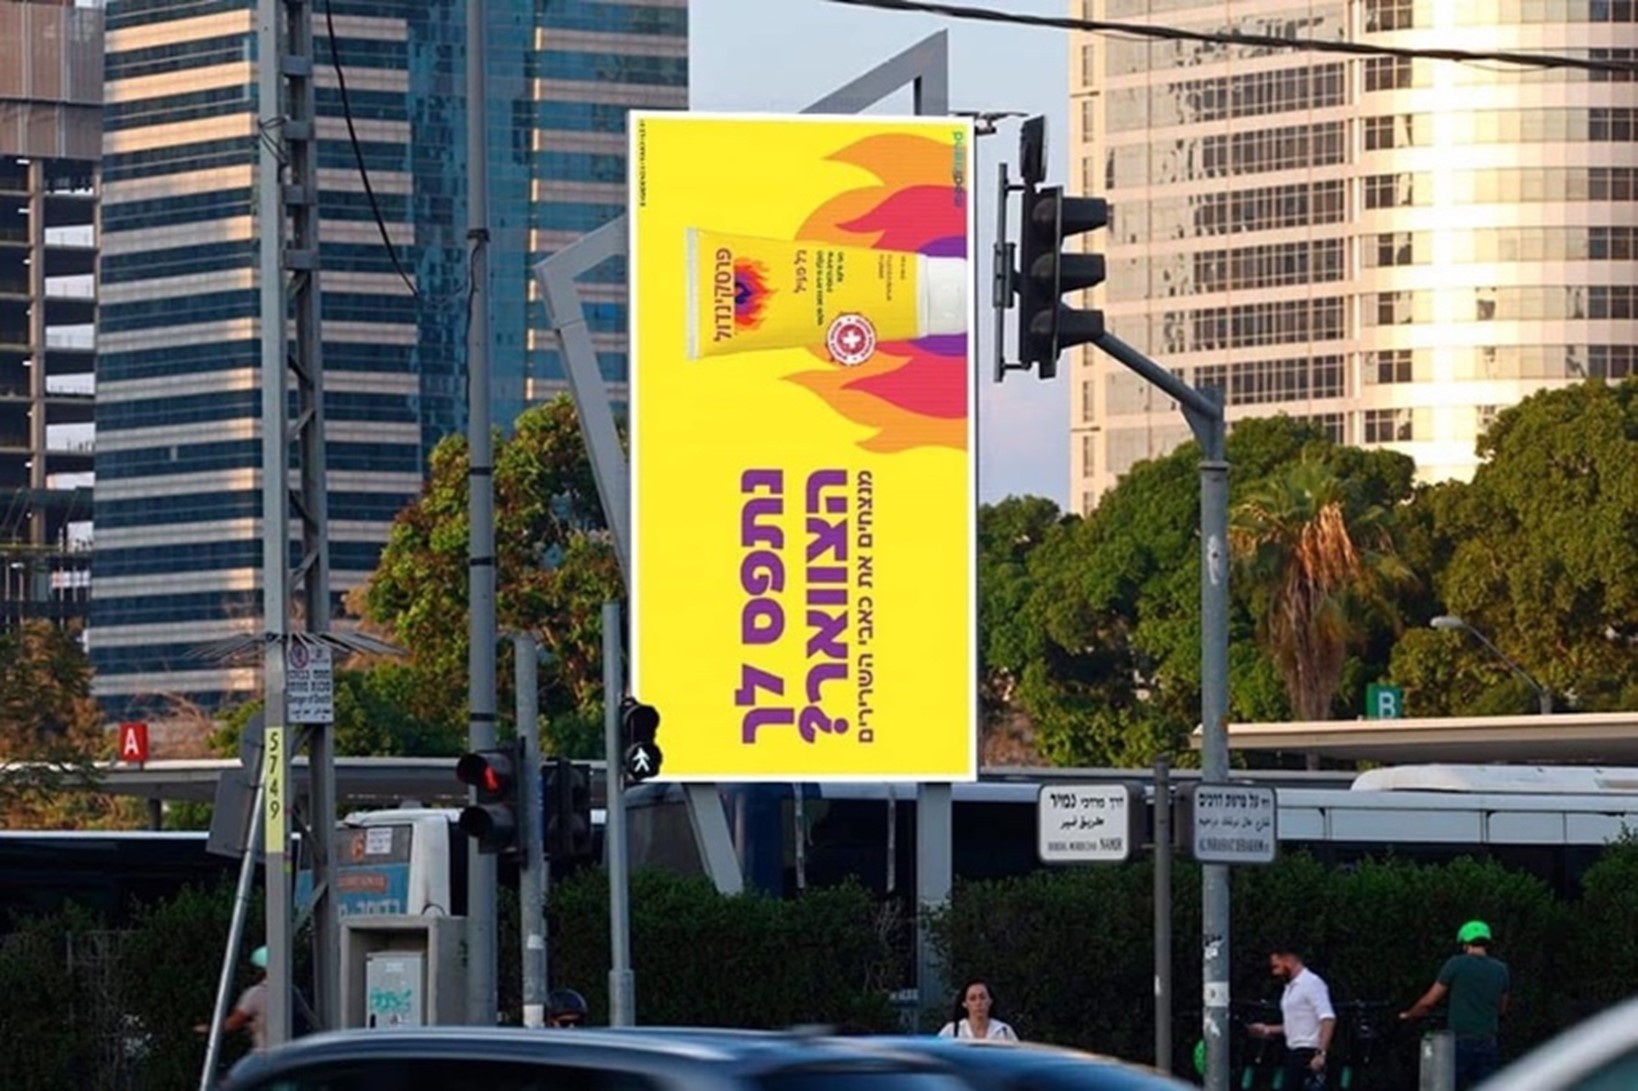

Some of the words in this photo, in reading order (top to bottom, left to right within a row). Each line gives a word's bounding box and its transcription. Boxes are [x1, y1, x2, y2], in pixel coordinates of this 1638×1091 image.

[713, 248, 733, 342] פרסקינדול
[857, 470, 873, 548] מנצחים
[740, 468, 785, 645] נתפס
[857, 556, 873, 588] את
[797, 468, 849, 744] הצוואר?
[857, 596, 873, 645] כאבי
[734, 663, 795, 745] לך
[857, 653, 873, 743] השרירים
[1378, 692, 1395, 718] B
[123, 728, 139, 755] A
[269, 733, 280, 819] 5749
